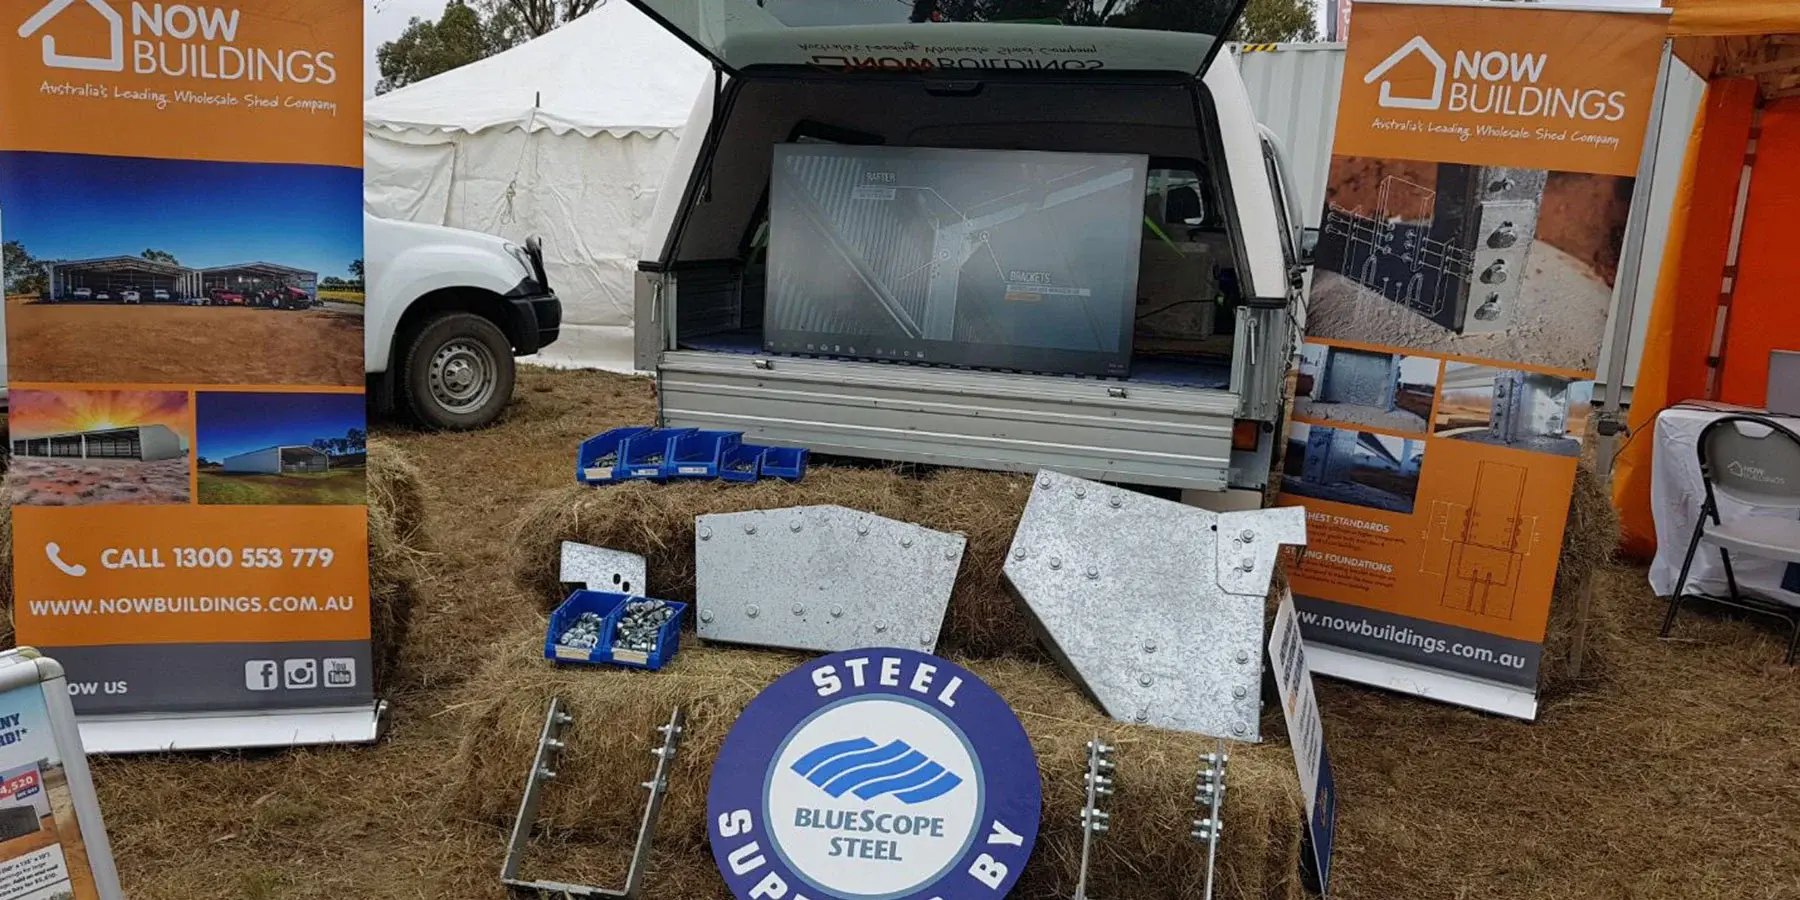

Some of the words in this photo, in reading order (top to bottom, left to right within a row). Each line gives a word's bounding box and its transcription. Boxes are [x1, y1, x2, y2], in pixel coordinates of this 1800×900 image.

[132, 2, 240, 42] NOW
[135, 41, 336, 84] BUILDINGS
[1453, 50, 1547, 83] NOW
[40, 81, 108, 98] Australia's
[174, 90, 238, 107] Wholesale
[244, 94, 279, 108] Shed
[284, 96, 336, 116] Company
[1448, 82, 1625, 121] BUILDINGS
[1371, 117, 1424, 133] Australia's
[1476, 125, 1530, 139] Wholesale
[1536, 127, 1565, 141] Shed
[1571, 131, 1619, 150] Company
[1333, 516, 1391, 533] STANDARDS
[100, 548, 165, 569] CALL
[172, 547, 233, 568] 1300
[240, 547, 283, 568] 553
[291, 548, 334, 568] 779
[1325, 553, 1393, 573] FOUNDATIONS
[29, 596, 354, 616] WWW.NOWBUILDINGS.COM.AU
[104, 681, 128, 695] US
[811, 657, 963, 708] STEEL
[828, 836, 902, 861] STEEL
[968, 820, 1024, 890] BY
